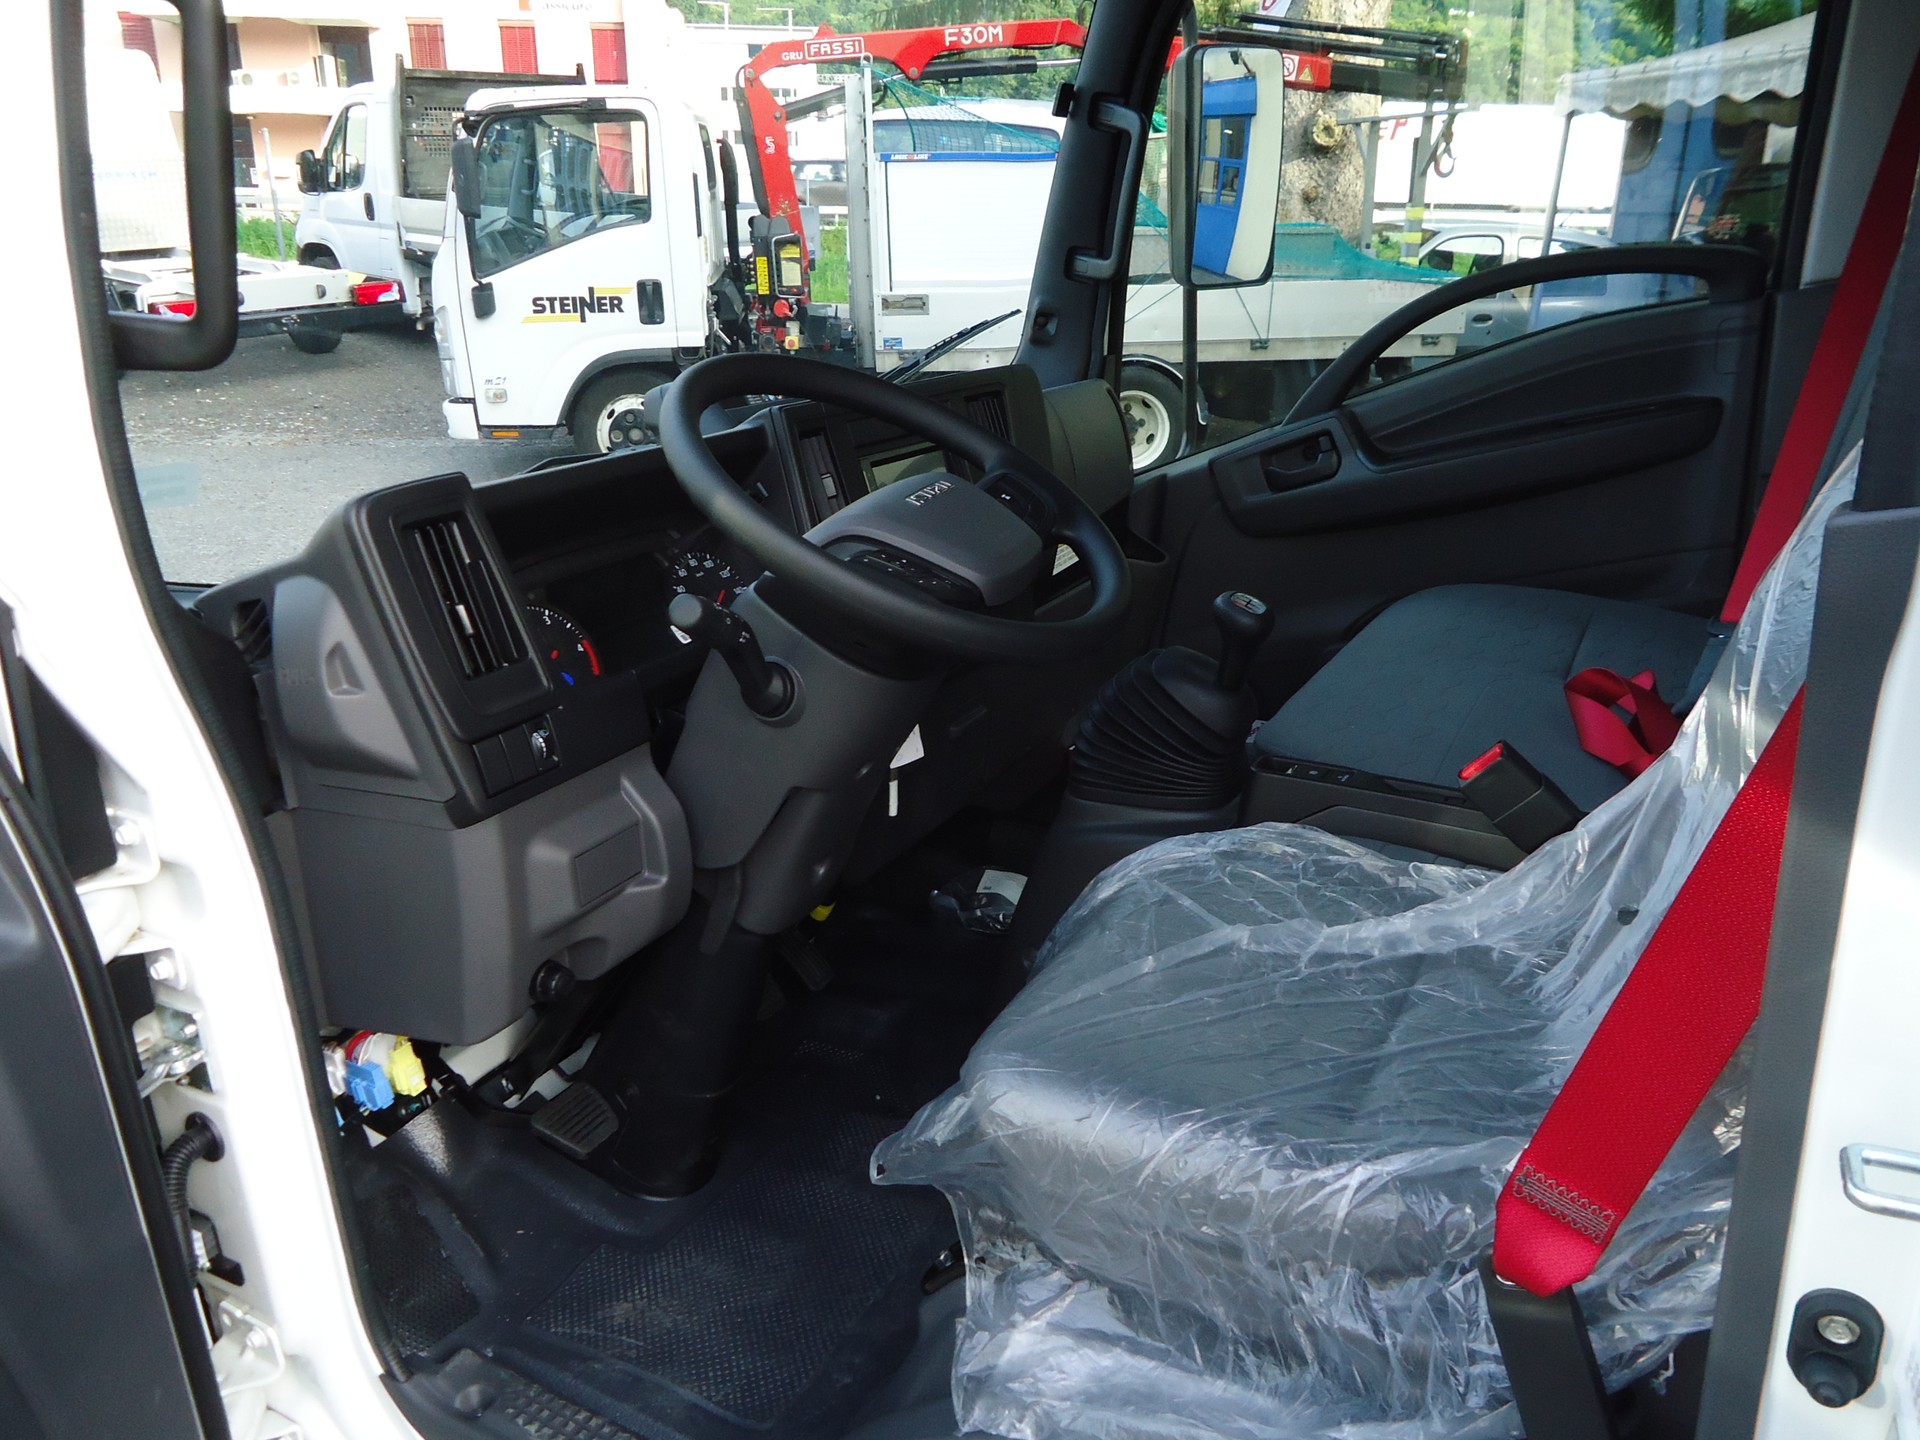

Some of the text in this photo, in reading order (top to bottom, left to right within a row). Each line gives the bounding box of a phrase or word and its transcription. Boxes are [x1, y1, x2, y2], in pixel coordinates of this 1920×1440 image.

[944, 25, 1004, 46] F30M
[781, 41, 861, 61] GRU FASSI
[531, 286, 625, 323] STEINER
[542, 615, 552, 625] 3
